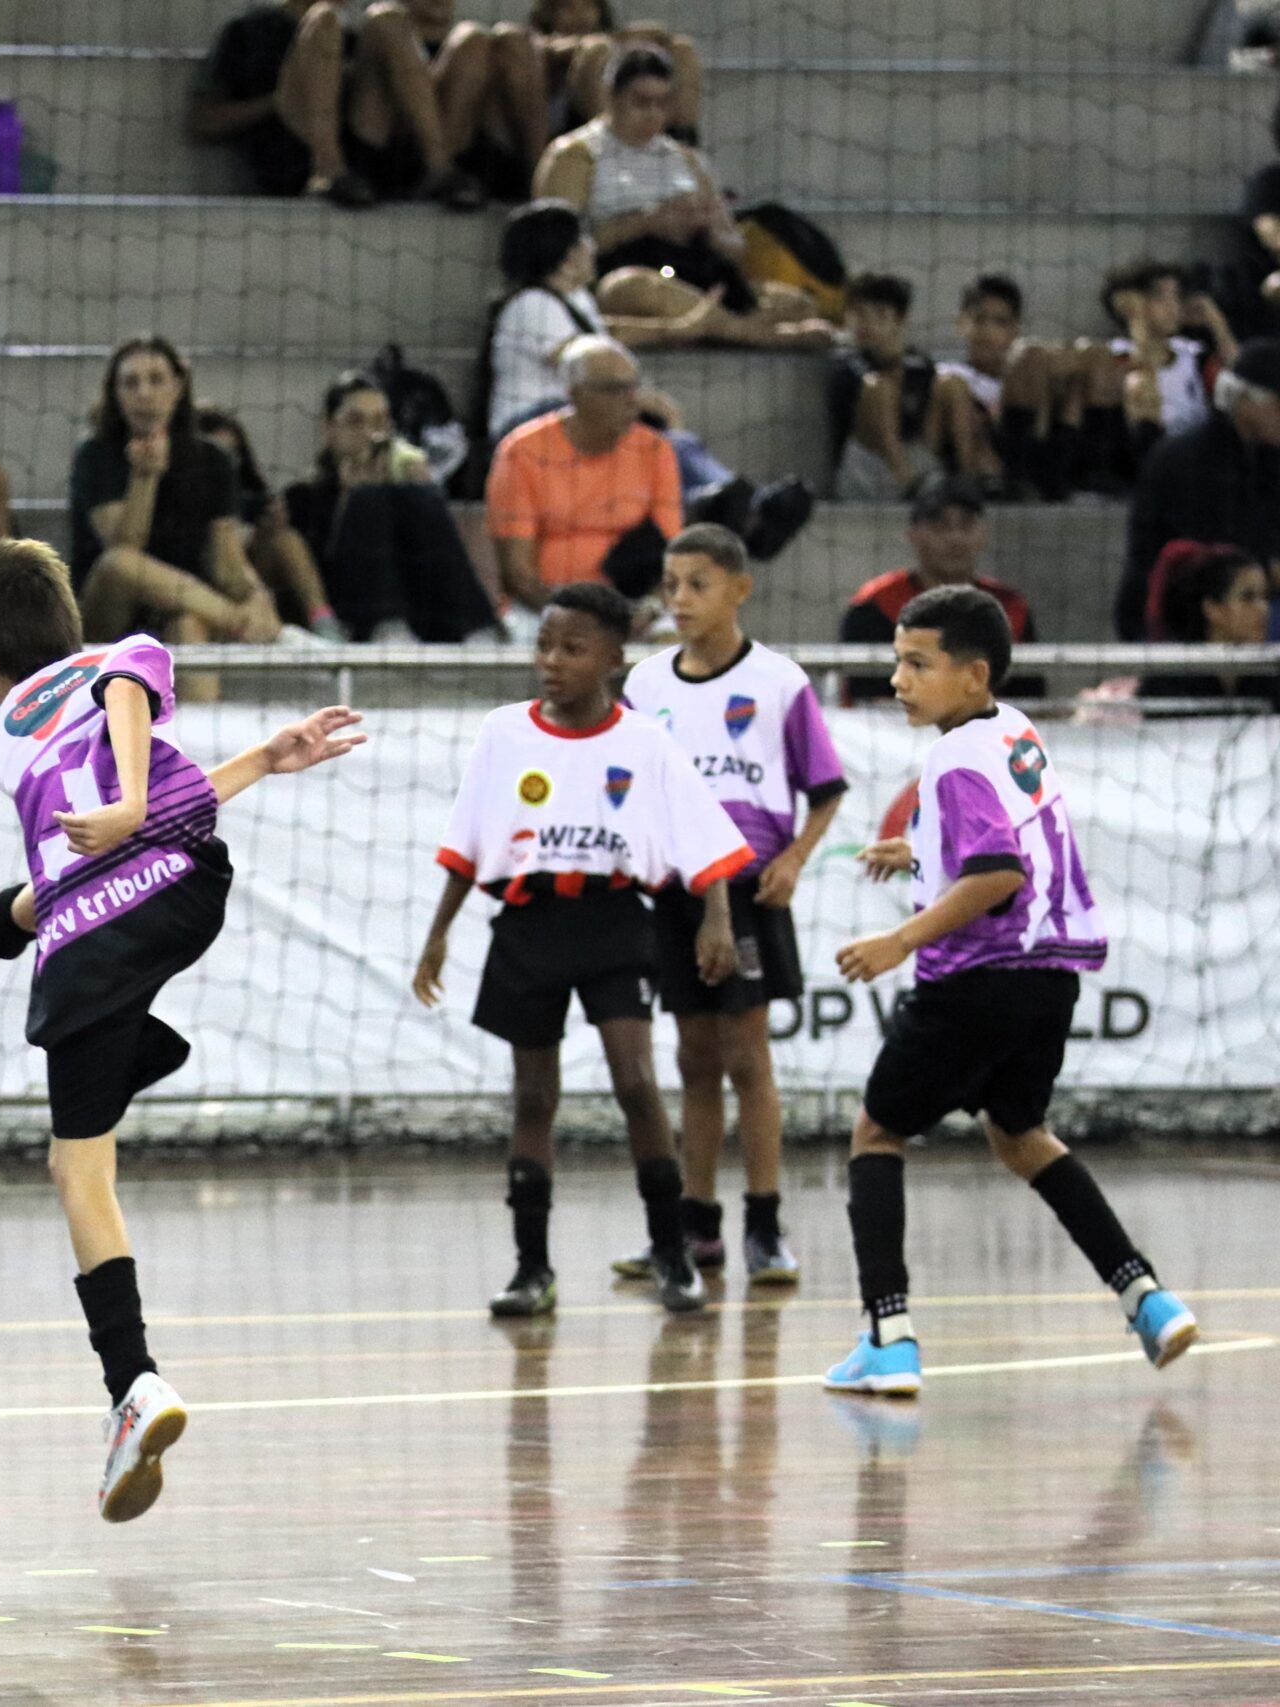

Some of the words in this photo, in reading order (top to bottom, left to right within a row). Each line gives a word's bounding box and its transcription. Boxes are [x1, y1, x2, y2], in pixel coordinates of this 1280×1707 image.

[693, 754, 764, 785] IZAD
[539, 824, 632, 859] WIZAR
[76, 853, 187, 921] tribuna
